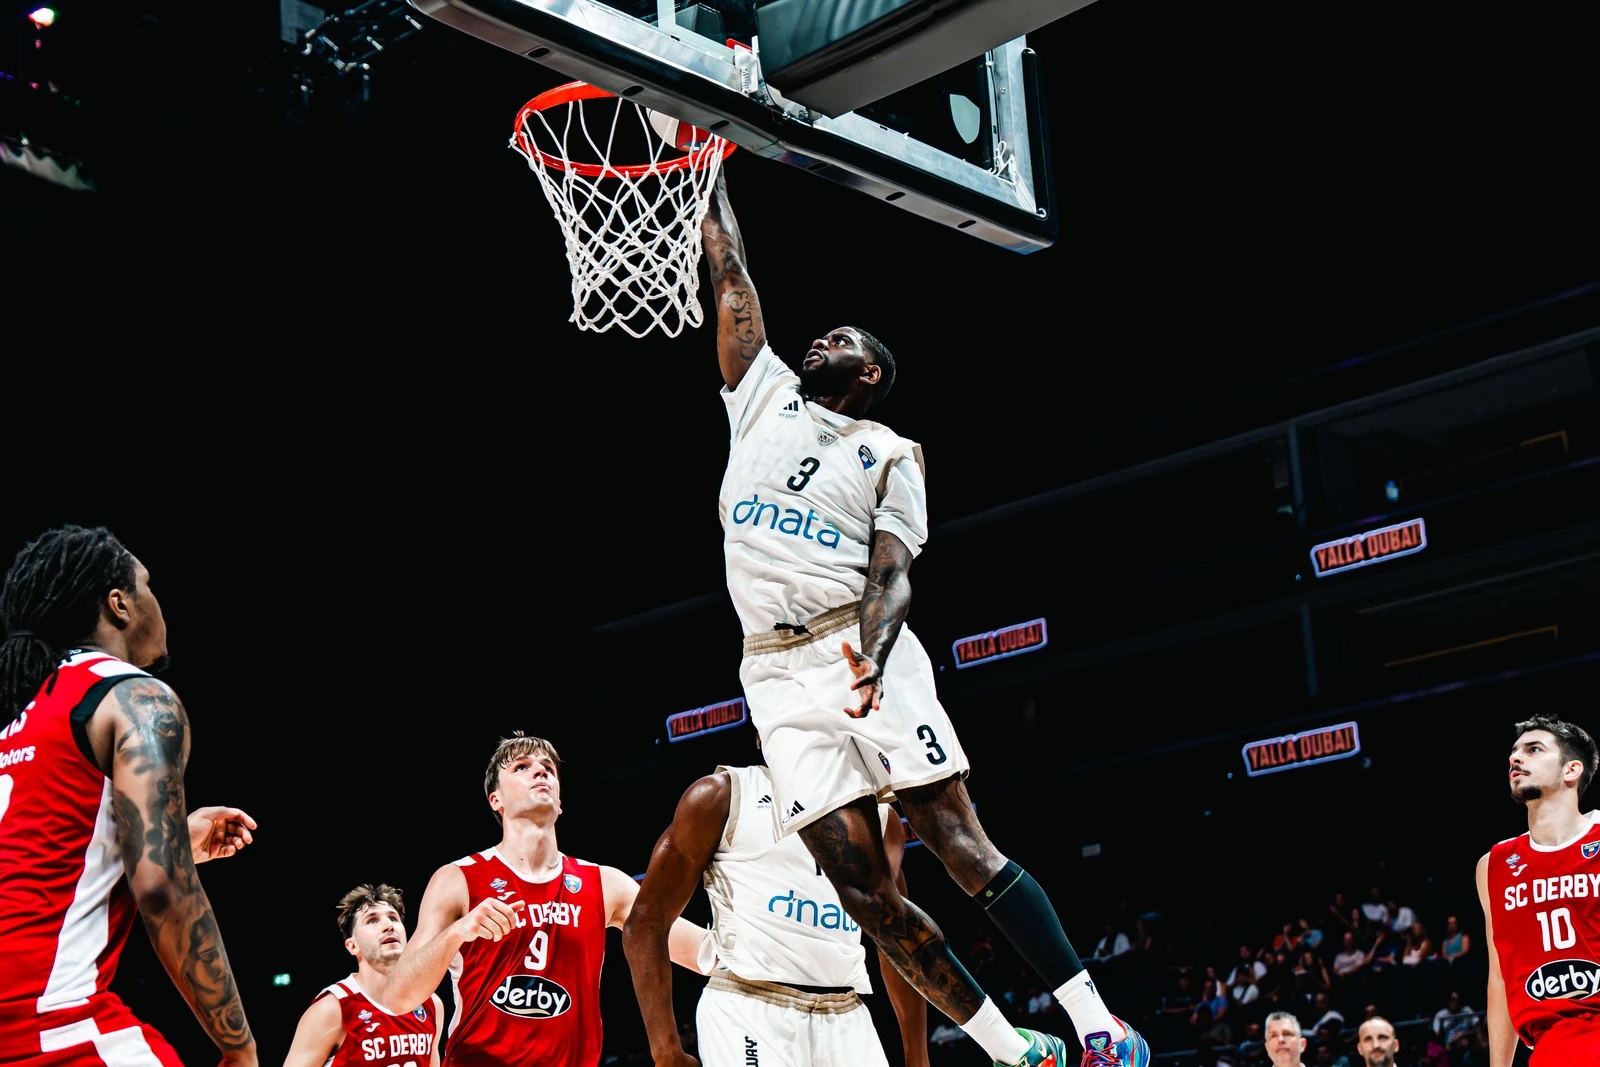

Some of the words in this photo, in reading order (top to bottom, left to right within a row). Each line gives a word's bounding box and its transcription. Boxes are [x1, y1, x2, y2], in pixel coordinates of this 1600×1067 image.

[787, 457, 820, 491] 3
[733, 494, 841, 549] dnata
[1317, 539, 1364, 570] YALLA
[957, 635, 996, 662] YALLA
[671, 712, 703, 736] YALLA
[0, 745, 36, 769] otors
[916, 724, 947, 765] 3
[1249, 739, 1297, 769] YALLA
[1504, 882, 1529, 911] SC
[1533, 873, 1600, 904] DERBY
[528, 901, 582, 928] DERBY
[1536, 907, 1576, 952] 10
[524, 930, 549, 971] 9
[492, 976, 567, 1016] derby
[1531, 965, 1600, 998] derby
[361, 1037, 386, 1061] SC
[389, 1033, 433, 1058] DERBY
